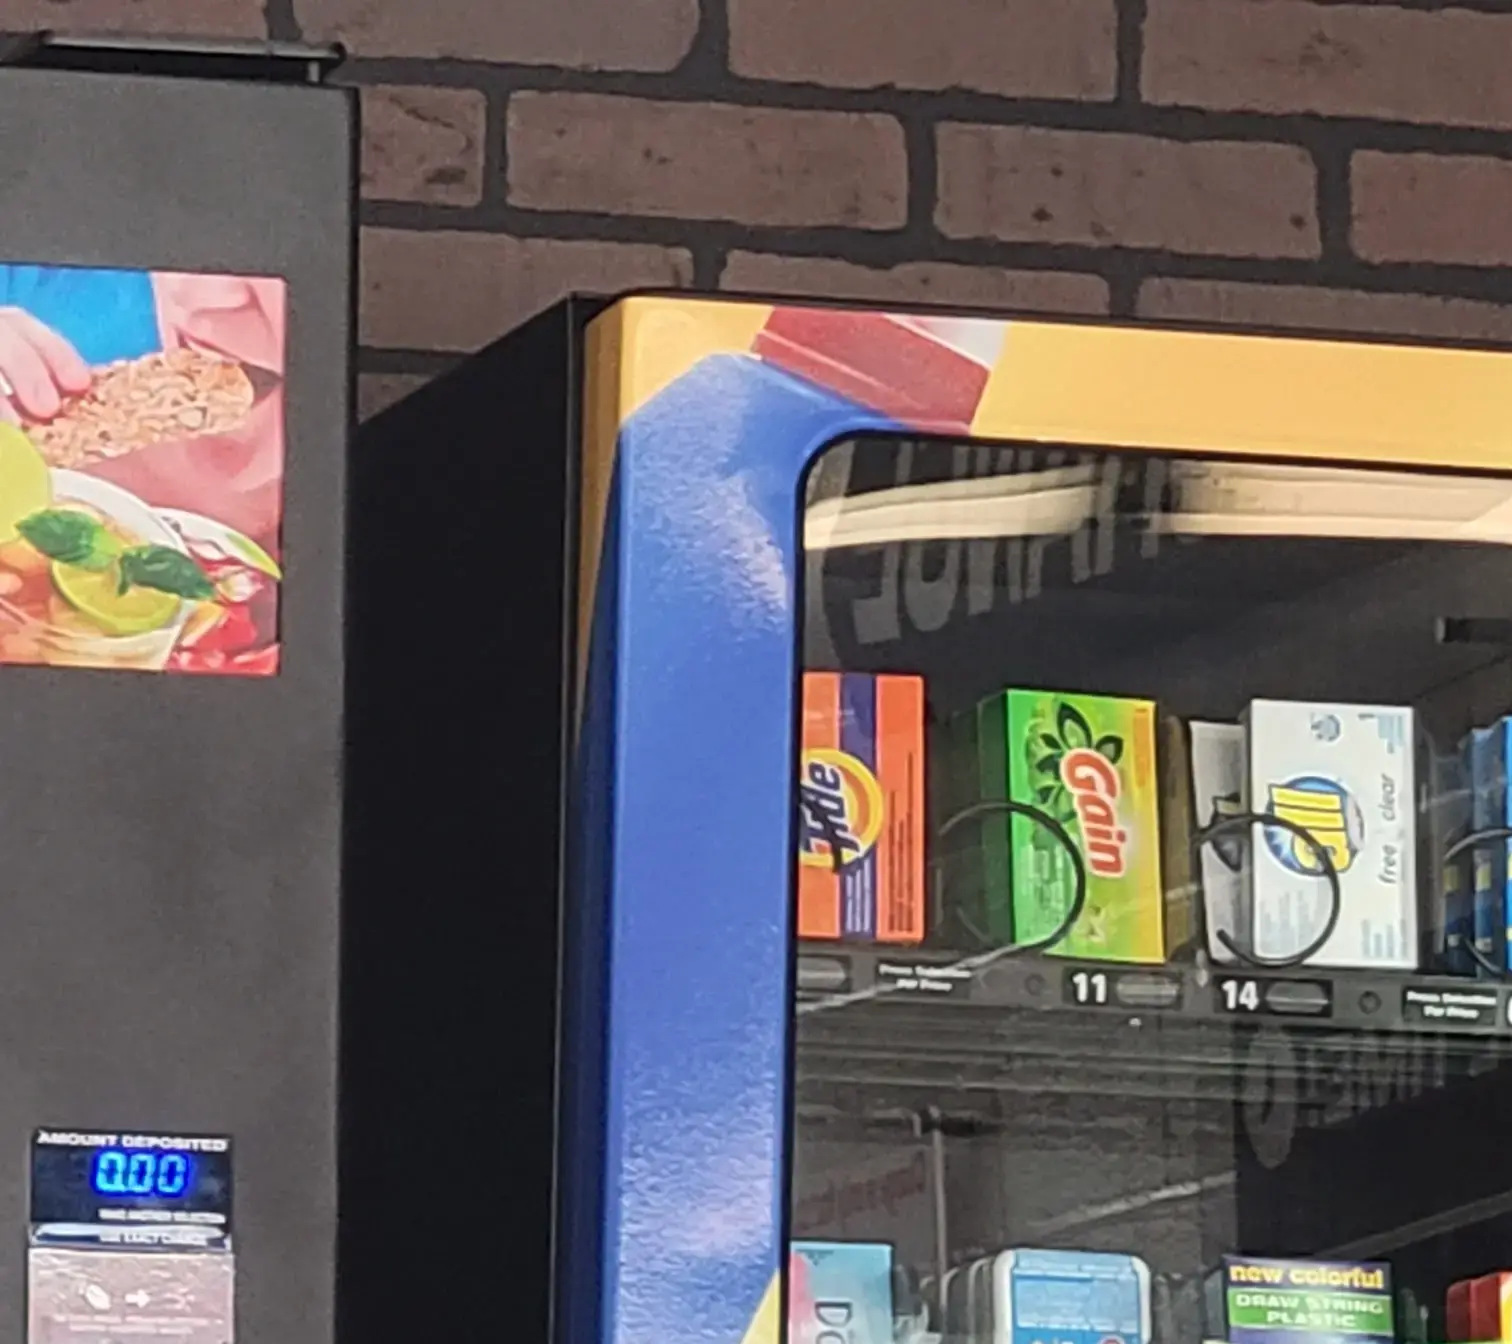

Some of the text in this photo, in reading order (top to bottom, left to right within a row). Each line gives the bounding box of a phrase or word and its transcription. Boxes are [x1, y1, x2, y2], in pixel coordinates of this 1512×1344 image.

[1063, 750, 1125, 875] Gain
[1072, 973, 1107, 1003] 11
[1221, 980, 1259, 1010] 14
[37, 1131, 230, 1152] AMOUNT DEPOSITED
[96, 1152, 188, 1193] 0.00
[1229, 1264, 1384, 1290] new colorful
[1236, 1293, 1383, 1315] DRAW STRING
[1267, 1311, 1357, 1328] PLASTIC
